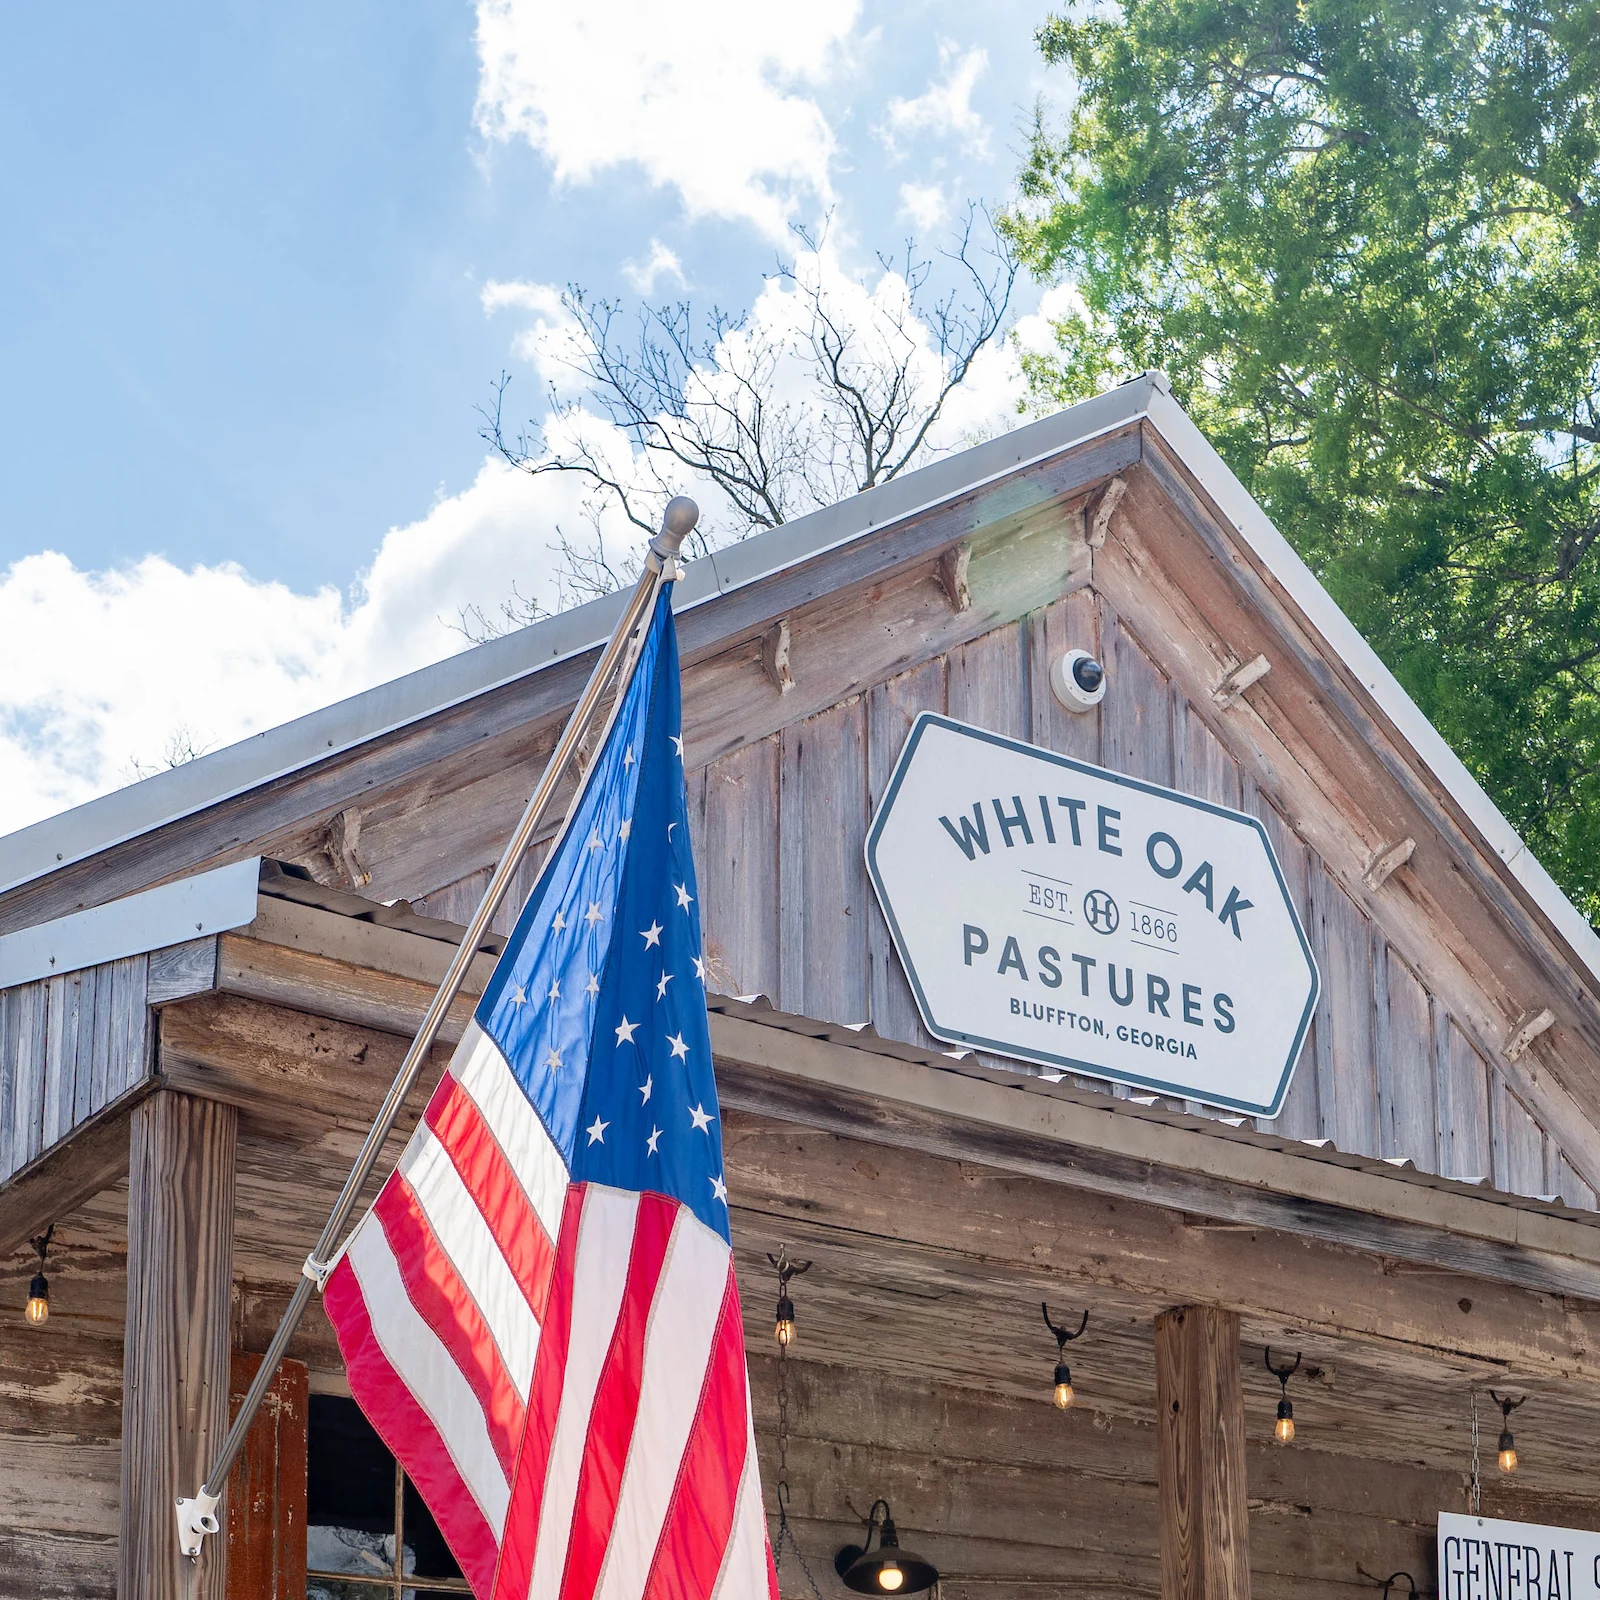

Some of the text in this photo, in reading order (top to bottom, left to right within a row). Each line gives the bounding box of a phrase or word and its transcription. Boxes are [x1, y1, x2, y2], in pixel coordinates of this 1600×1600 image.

[939, 794, 1255, 942] WHITE OAK
[1029, 884, 1073, 915] EST.
[1130, 912, 1178, 943] 1866
[963, 924, 1236, 1034] PASTURES
[1010, 998, 1198, 1060] BLUFFTON, GEORGIA
